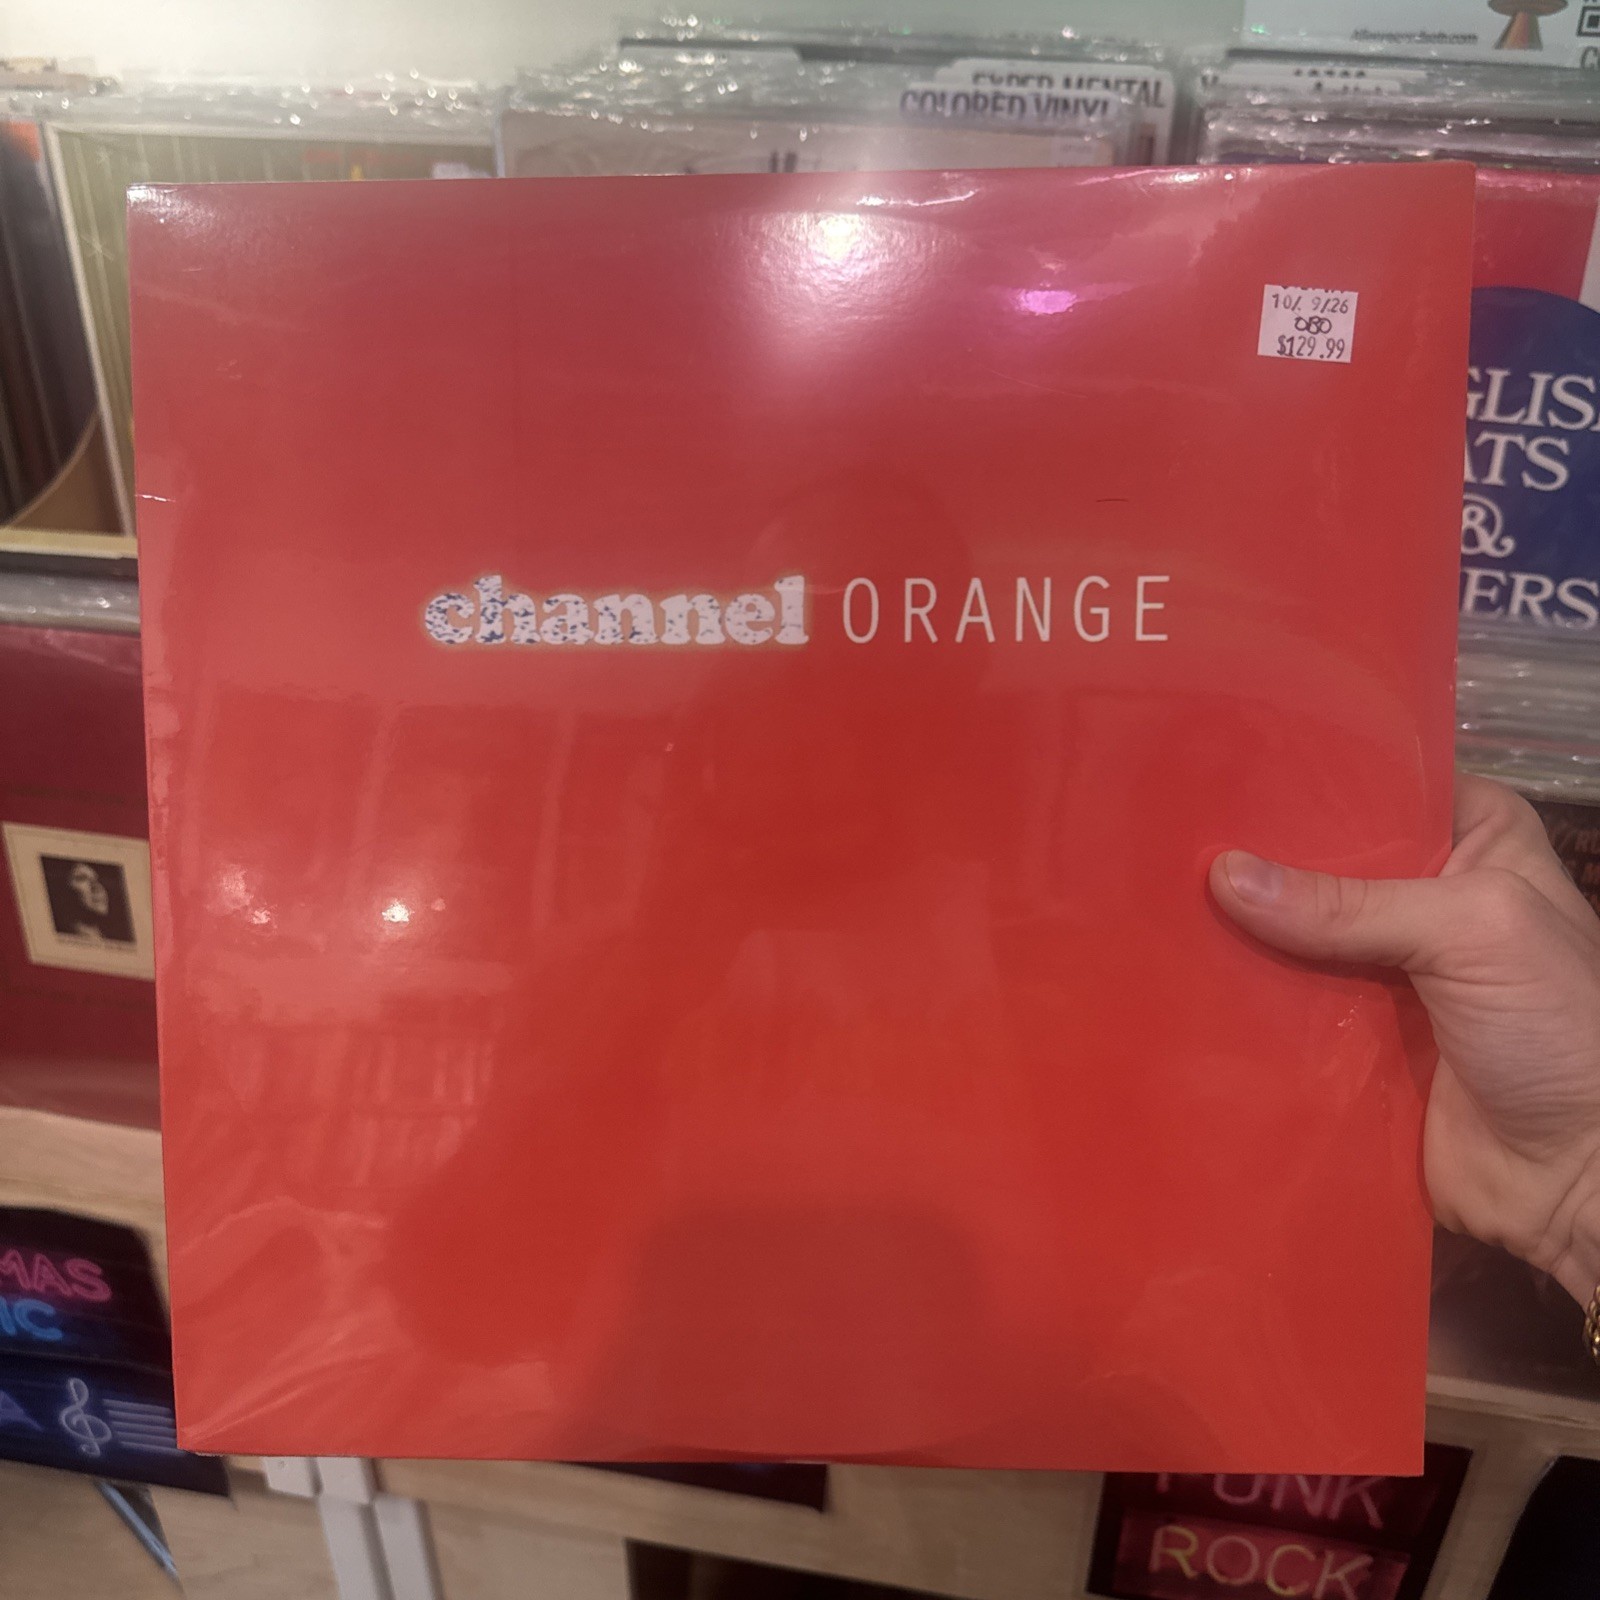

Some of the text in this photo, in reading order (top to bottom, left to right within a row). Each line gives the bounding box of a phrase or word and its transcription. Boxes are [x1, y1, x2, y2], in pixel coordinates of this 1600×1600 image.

[1276, 334, 1345, 359] $129.99
[424, 575, 1170, 646] channel ORANGE
[1148, 1524, 1374, 1600] ROCK
